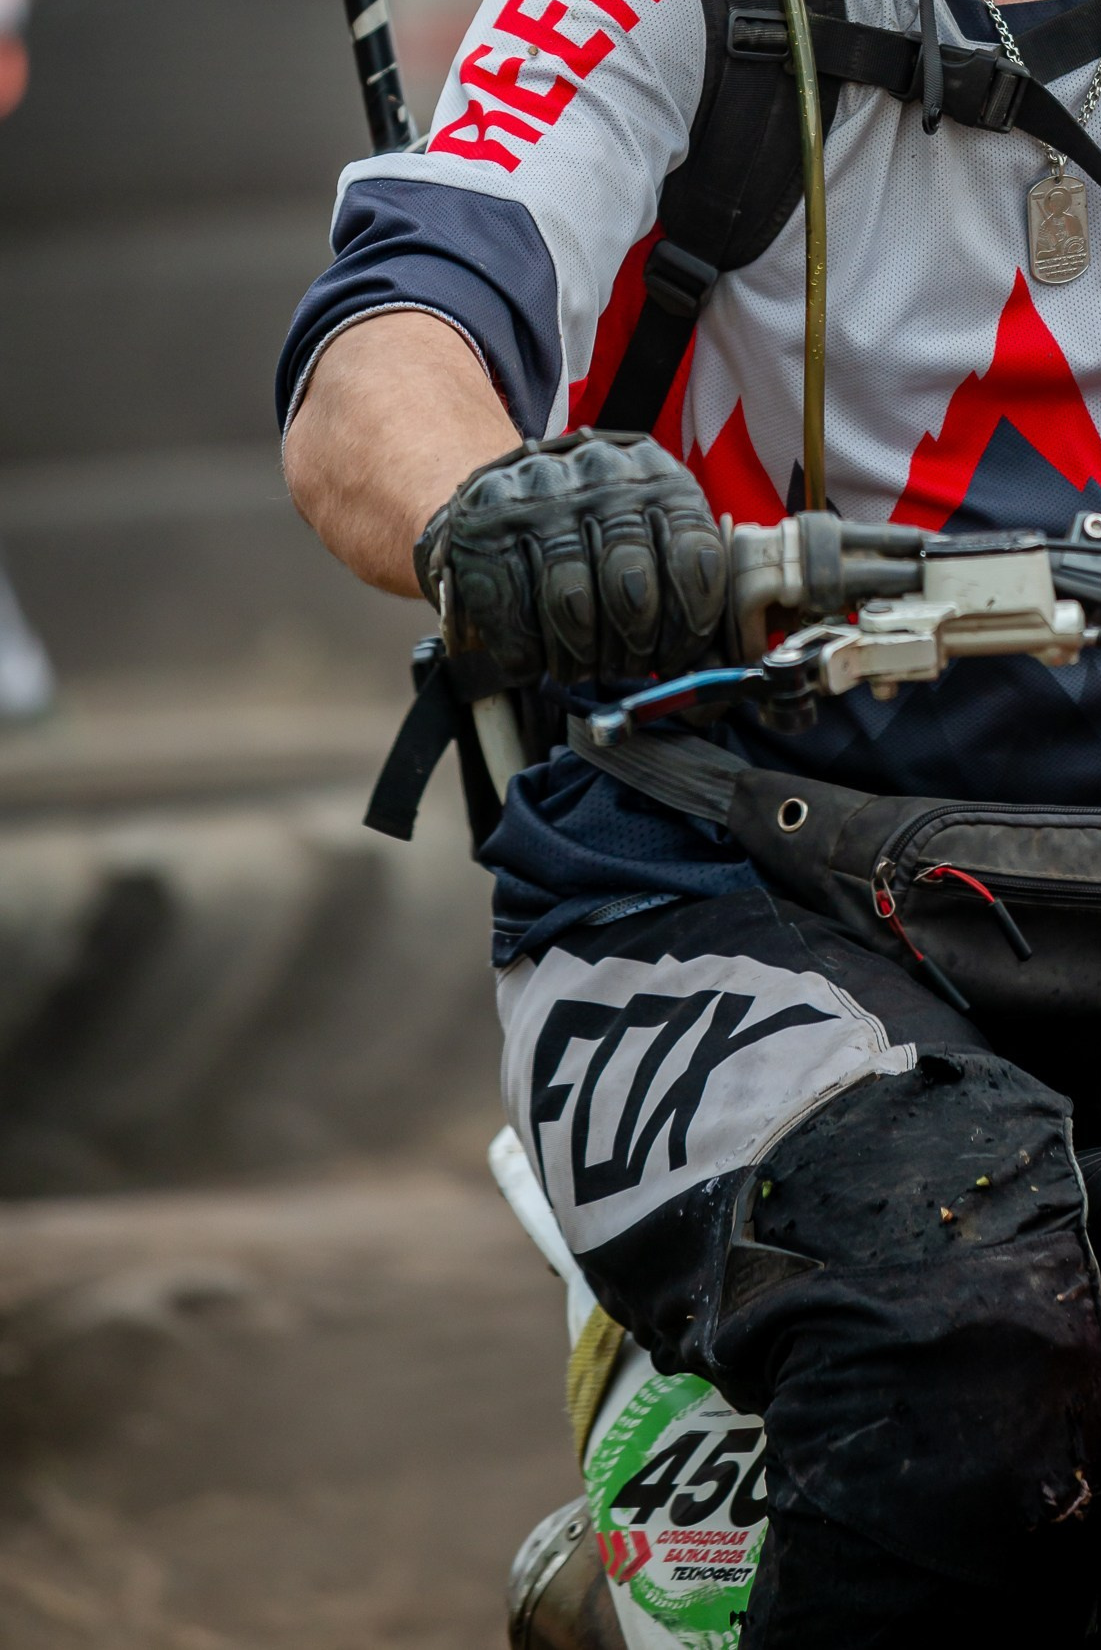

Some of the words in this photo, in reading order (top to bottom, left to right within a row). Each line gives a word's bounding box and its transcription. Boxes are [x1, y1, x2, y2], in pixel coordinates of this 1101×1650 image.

[530, 989, 842, 1209] FOX
[656, 1530, 750, 1547] СЛОБОДСКАЯ
[662, 1548, 711, 1563] БАЛКА
[708, 1549, 747, 1564] 2025
[670, 1566, 754, 1583] ТЕХНОФЕСТ
